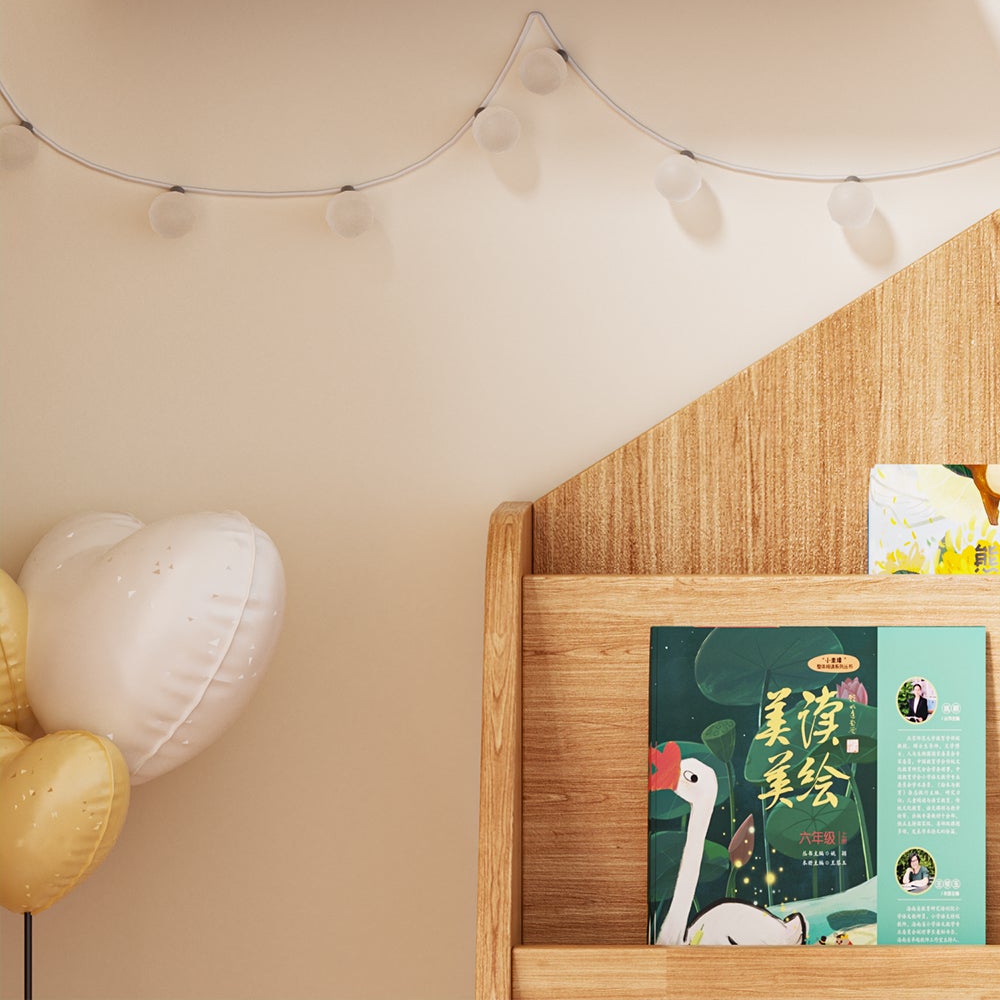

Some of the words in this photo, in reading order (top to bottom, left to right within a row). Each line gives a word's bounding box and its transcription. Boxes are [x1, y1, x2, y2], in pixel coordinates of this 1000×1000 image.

[757, 751, 851, 810] 美绘
[799, 831, 835, 845] 六年级
